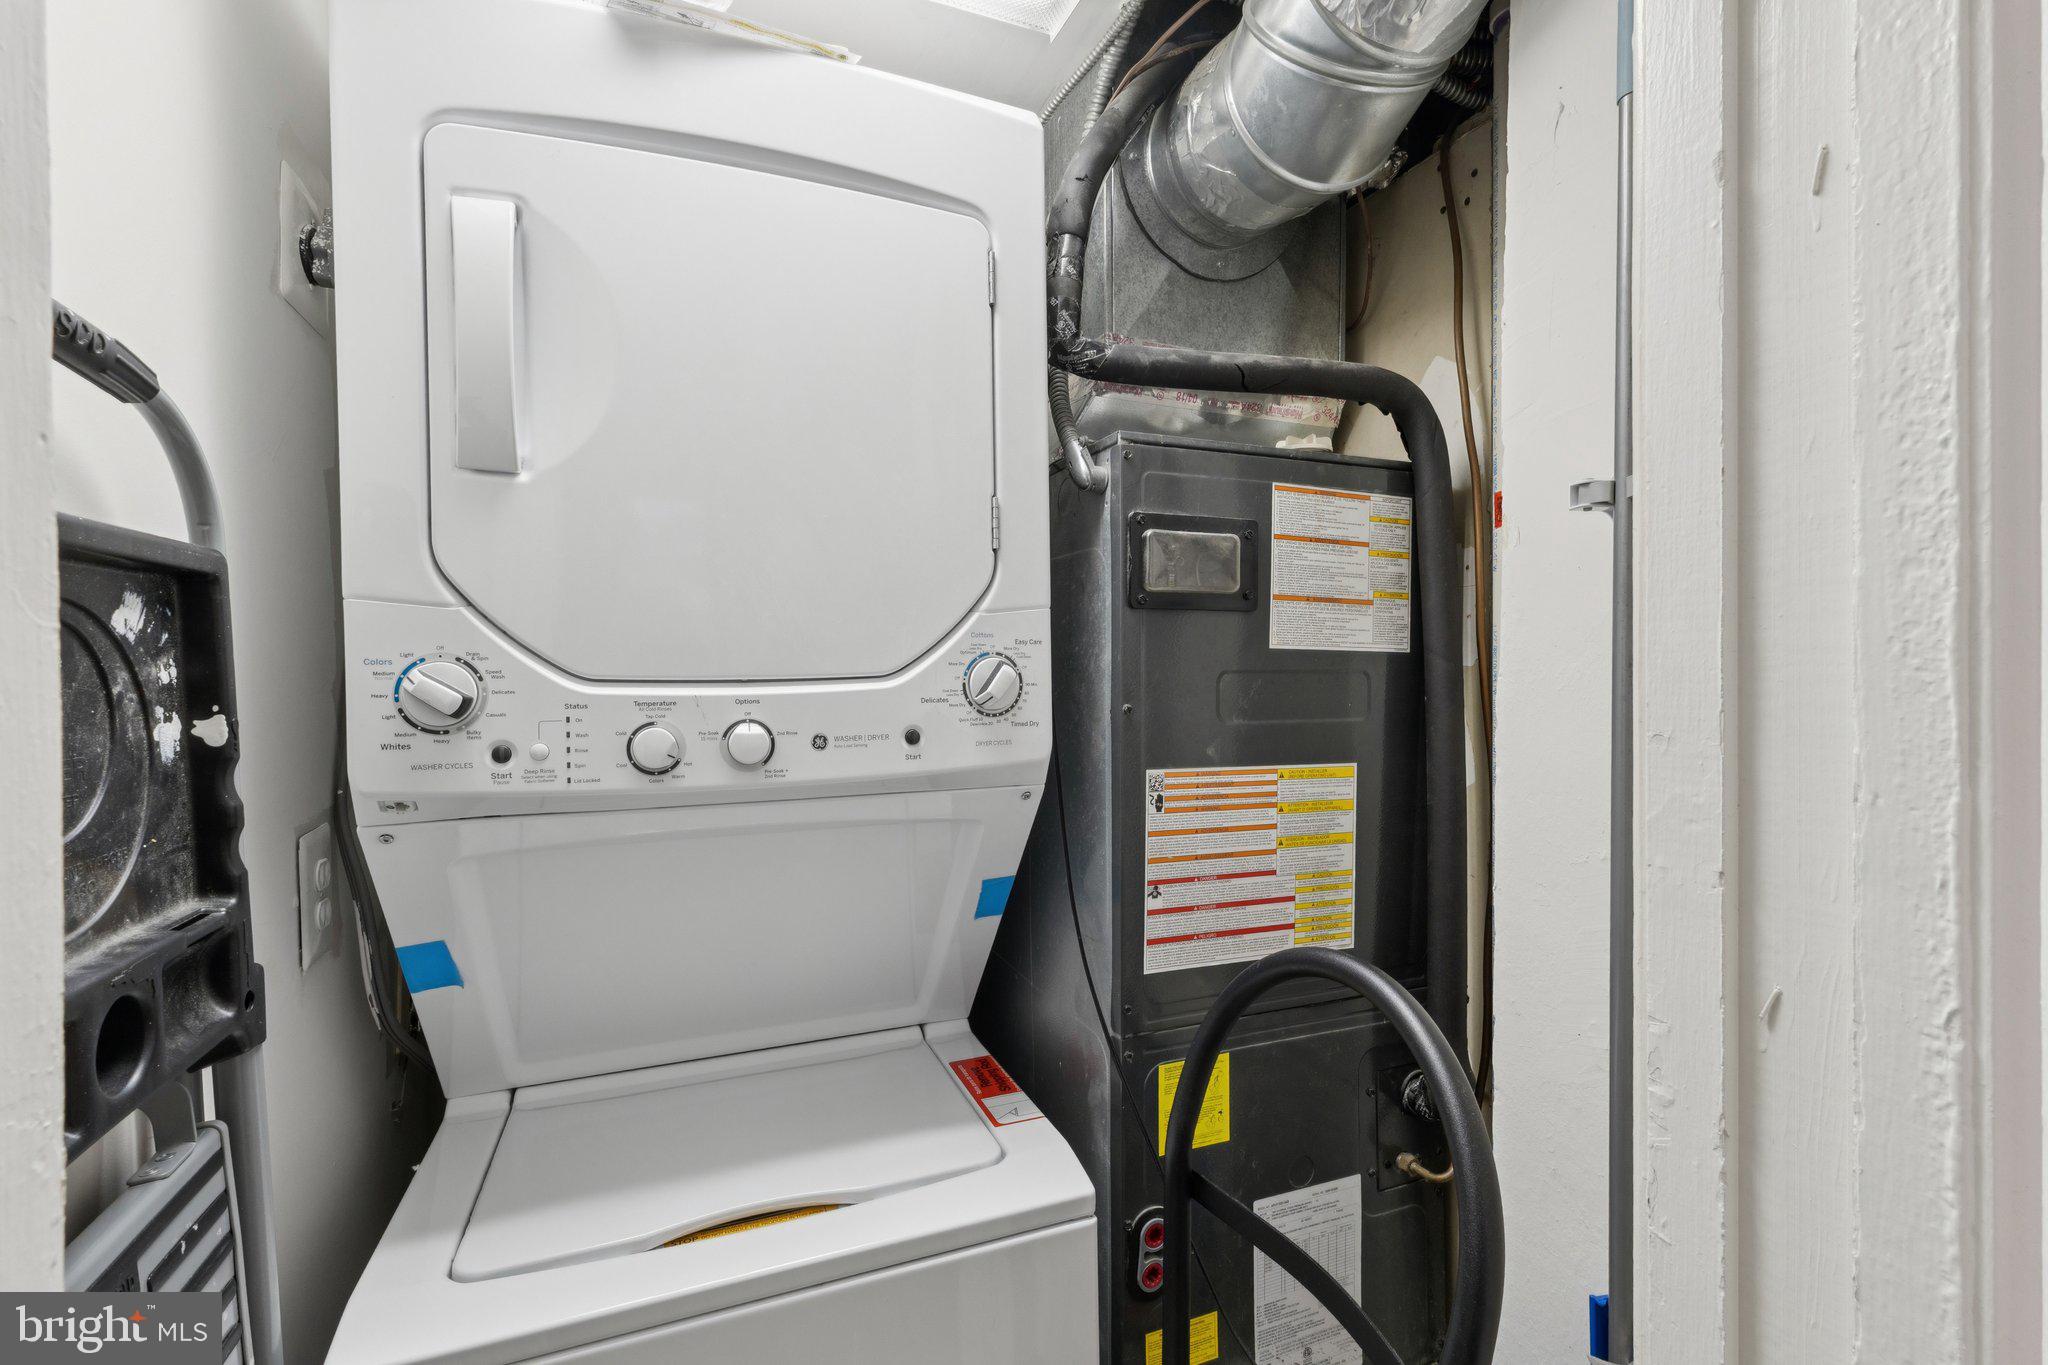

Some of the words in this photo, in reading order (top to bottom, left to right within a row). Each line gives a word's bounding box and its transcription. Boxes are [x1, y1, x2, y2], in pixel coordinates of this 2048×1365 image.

[410, 763, 444, 771] WASHER
[445, 762, 474, 770] CYCLES
[672, 1236, 698, 1246] STOP
